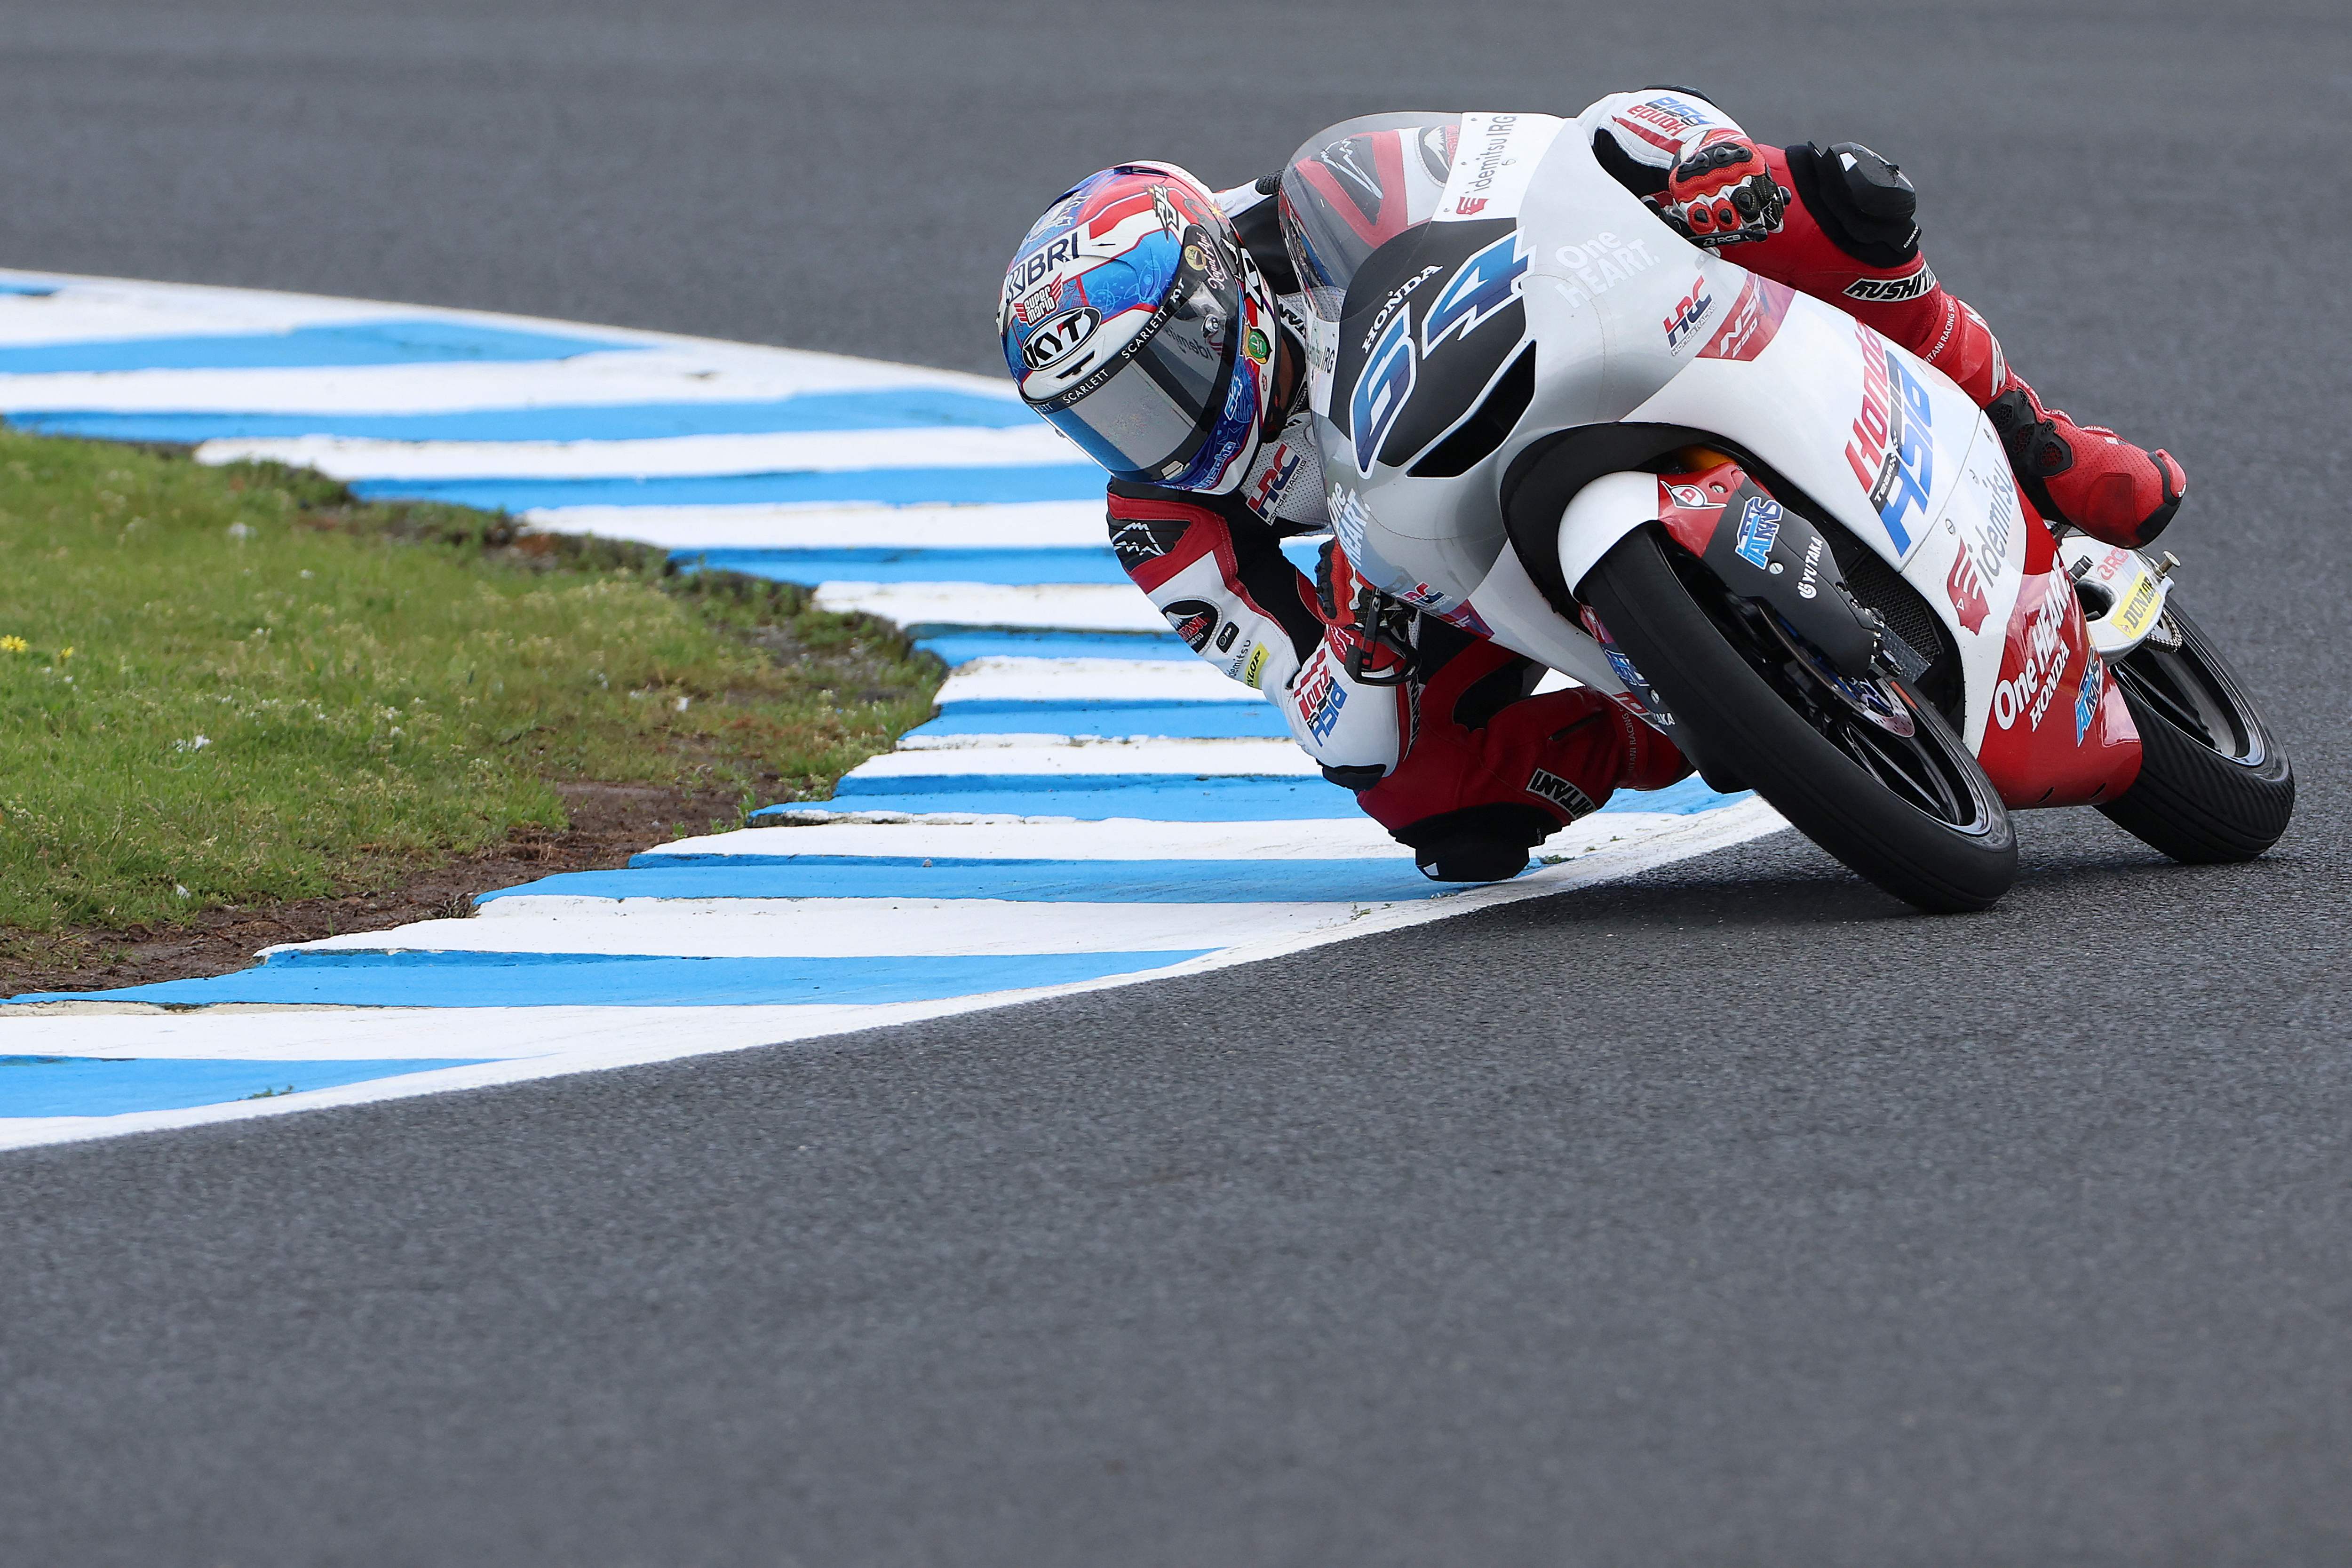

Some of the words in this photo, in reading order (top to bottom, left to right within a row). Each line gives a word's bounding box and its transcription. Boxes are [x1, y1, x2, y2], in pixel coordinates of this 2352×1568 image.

[1486, 116, 1518, 140] IRG
[1627, 105, 1689, 137] Honda
[1465, 135, 1508, 194] idemitsu
[1027, 231, 1080, 286] BRI
[1555, 231, 1621, 269] One
[1717, 234, 1741, 243] RCB
[1554, 238, 1661, 309] HEART.
[1122, 306, 1168, 359] SCARLETT
[1362, 264, 1443, 353] HONDA
[1663, 275, 1713, 348] HRC
[1671, 327, 1698, 357] Honda
[1695, 302, 1717, 334] RACING
[1940, 312, 1955, 342] RACING
[1024, 308, 1085, 368] KYT
[1350, 225, 1537, 479] 64
[1063, 369, 1109, 404] SCARLETT
[1247, 443, 1301, 520] HRC
[1285, 459, 1307, 493] RACING
[1874, 466, 1894, 502] Team
[1967, 458, 2014, 589] idemitsu
[1803, 536, 1824, 584] YUTAKA
[2123, 576, 2157, 629] DUNLOP
[1994, 658, 2038, 730] One
[2029, 639, 2070, 732] HONDA
